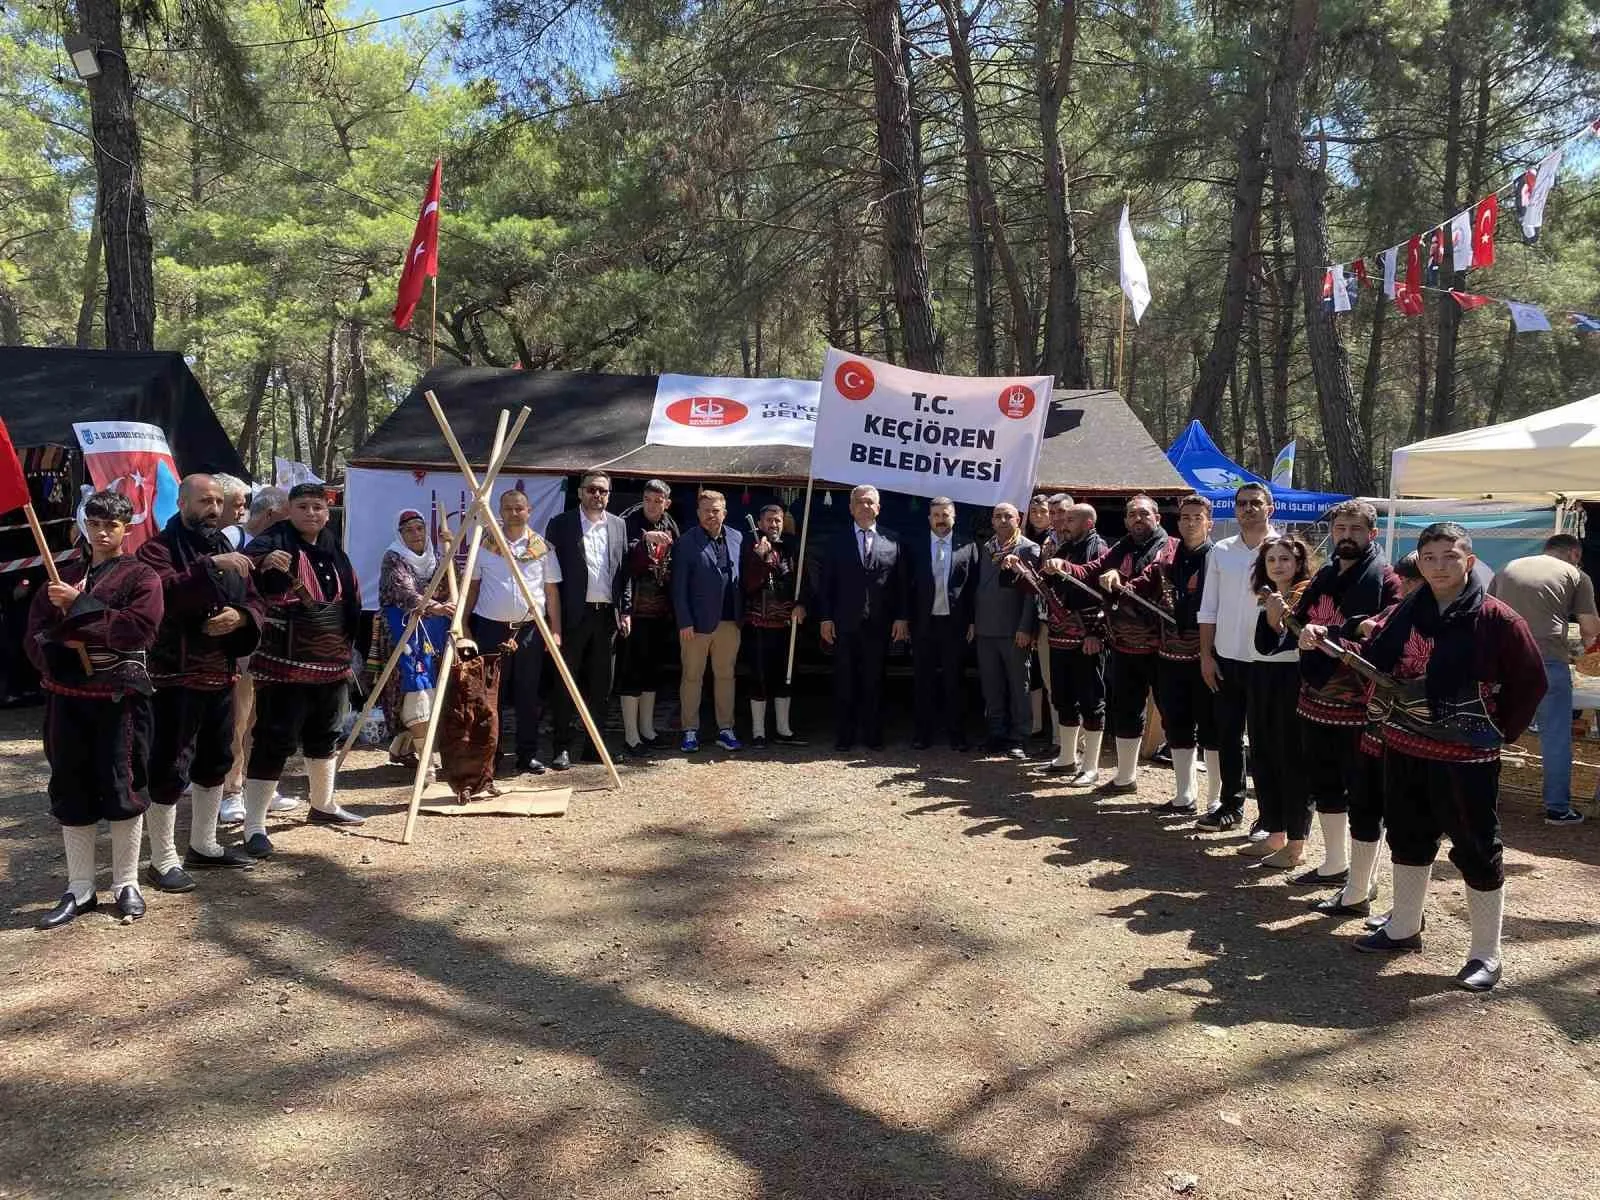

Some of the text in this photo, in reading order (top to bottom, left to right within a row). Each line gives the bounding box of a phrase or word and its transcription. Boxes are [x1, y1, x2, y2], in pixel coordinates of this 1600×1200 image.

[912, 392, 954, 414] T.C.
[864, 414, 995, 450] KEÇİÖREN
[850, 442, 1002, 483] BELEDİYESİ
